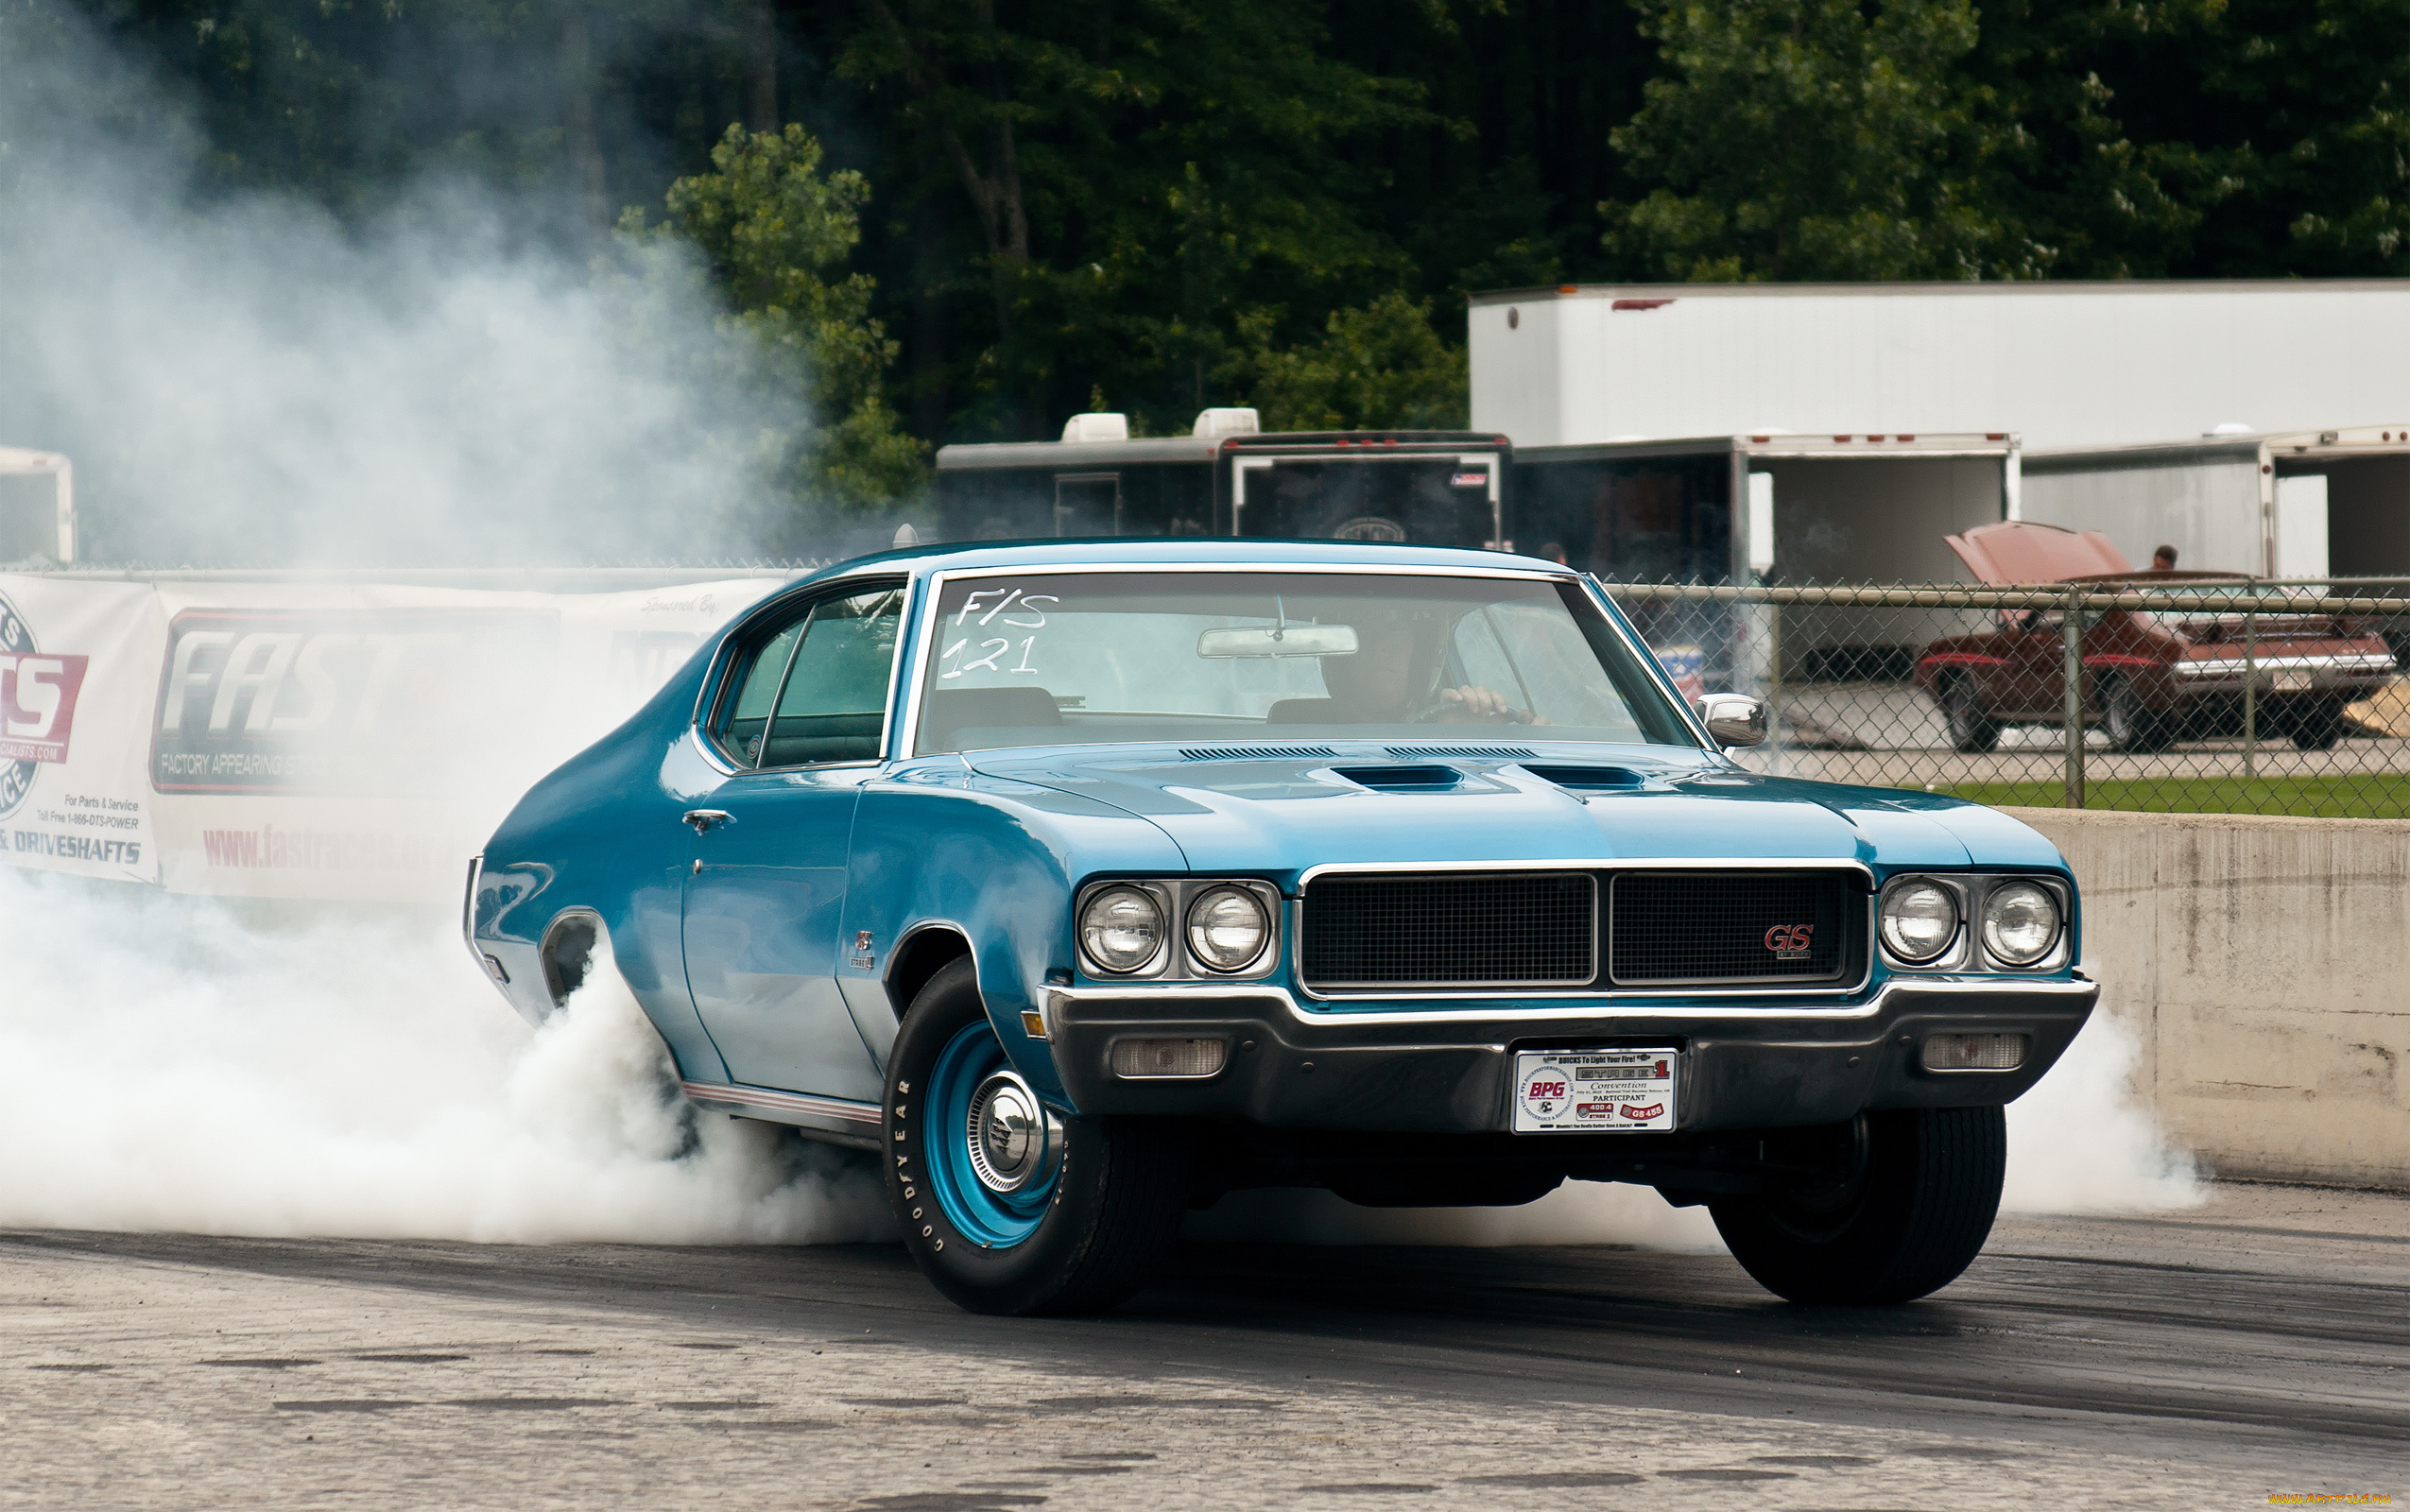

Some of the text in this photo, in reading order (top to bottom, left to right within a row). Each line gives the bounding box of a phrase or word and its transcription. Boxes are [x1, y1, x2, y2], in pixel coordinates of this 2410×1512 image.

[955, 588, 1059, 628] F/S
[941, 635, 1038, 679] 121
[162, 630, 463, 734] FAST
[161, 753, 210, 775] FACTORY
[211, 754, 282, 776] APPEARING
[64, 794, 139, 812] For Parts & Service
[50, 811, 66, 823] Free
[14, 831, 142, 865] DRIVESHAFTS
[1764, 924, 1815, 951] GS
[1591, 1056, 1606, 1064] Light
[1581, 1069, 1649, 1078] STAGE
[1529, 1082, 1565, 1096] BPG
[1591, 1081, 1647, 1091] Convention
[1645, 1107, 1661, 1117] 455
[895, 1080, 943, 1252] GOODYEAR
